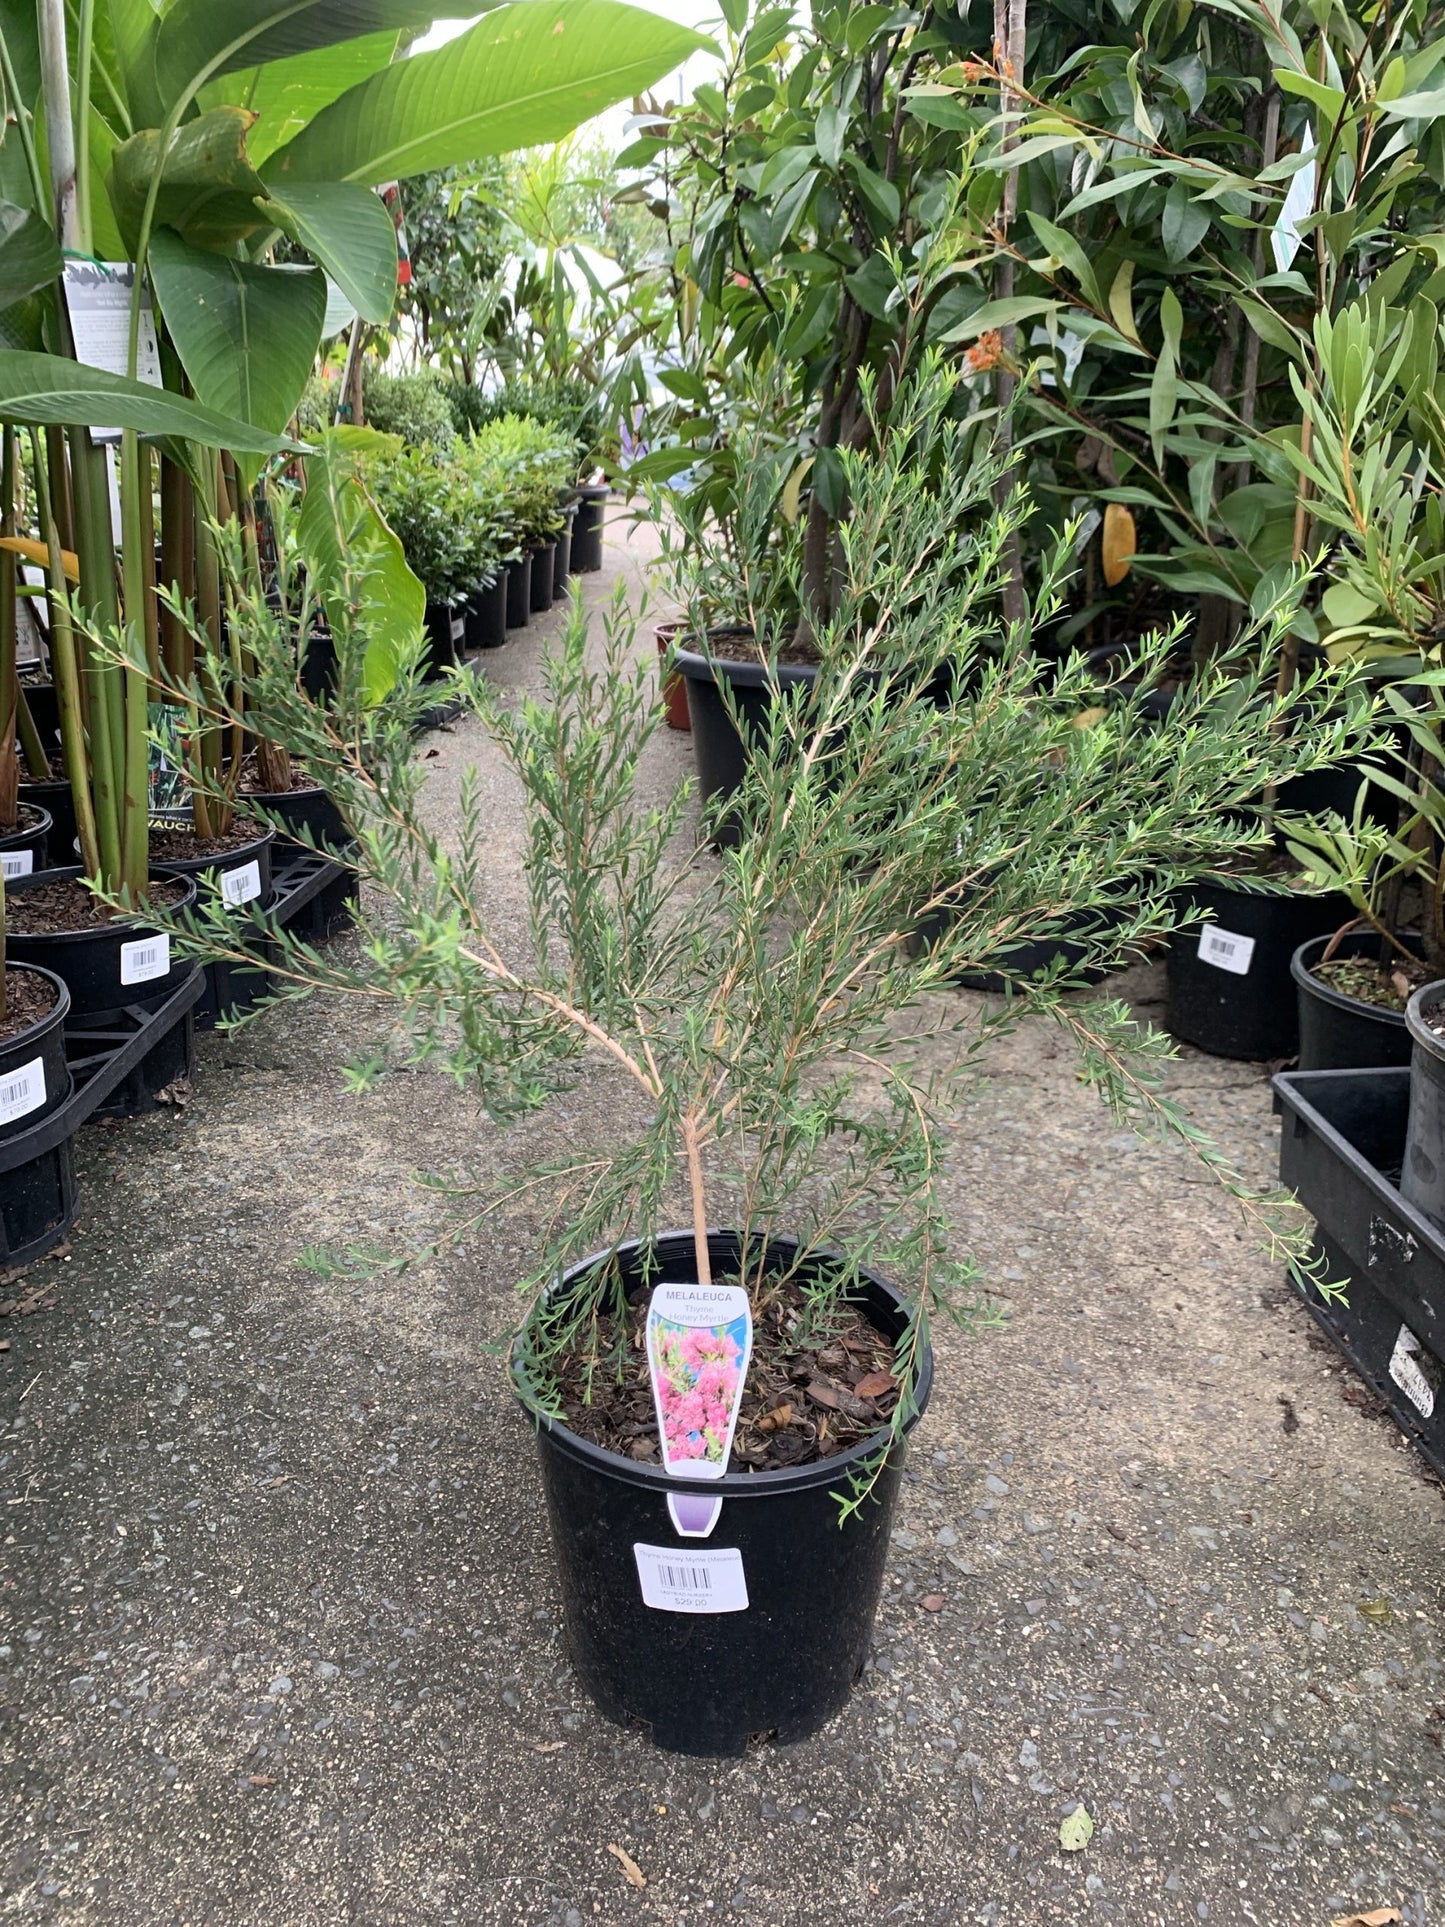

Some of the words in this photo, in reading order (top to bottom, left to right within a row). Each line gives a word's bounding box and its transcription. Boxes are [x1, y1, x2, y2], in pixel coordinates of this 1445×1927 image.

[666, 1291, 733, 1302] MELALEUCA
[685, 1304, 714, 1314] Thyme
[669, 1312, 698, 1322] Honey
[699, 1313, 730, 1323] Myrtle
